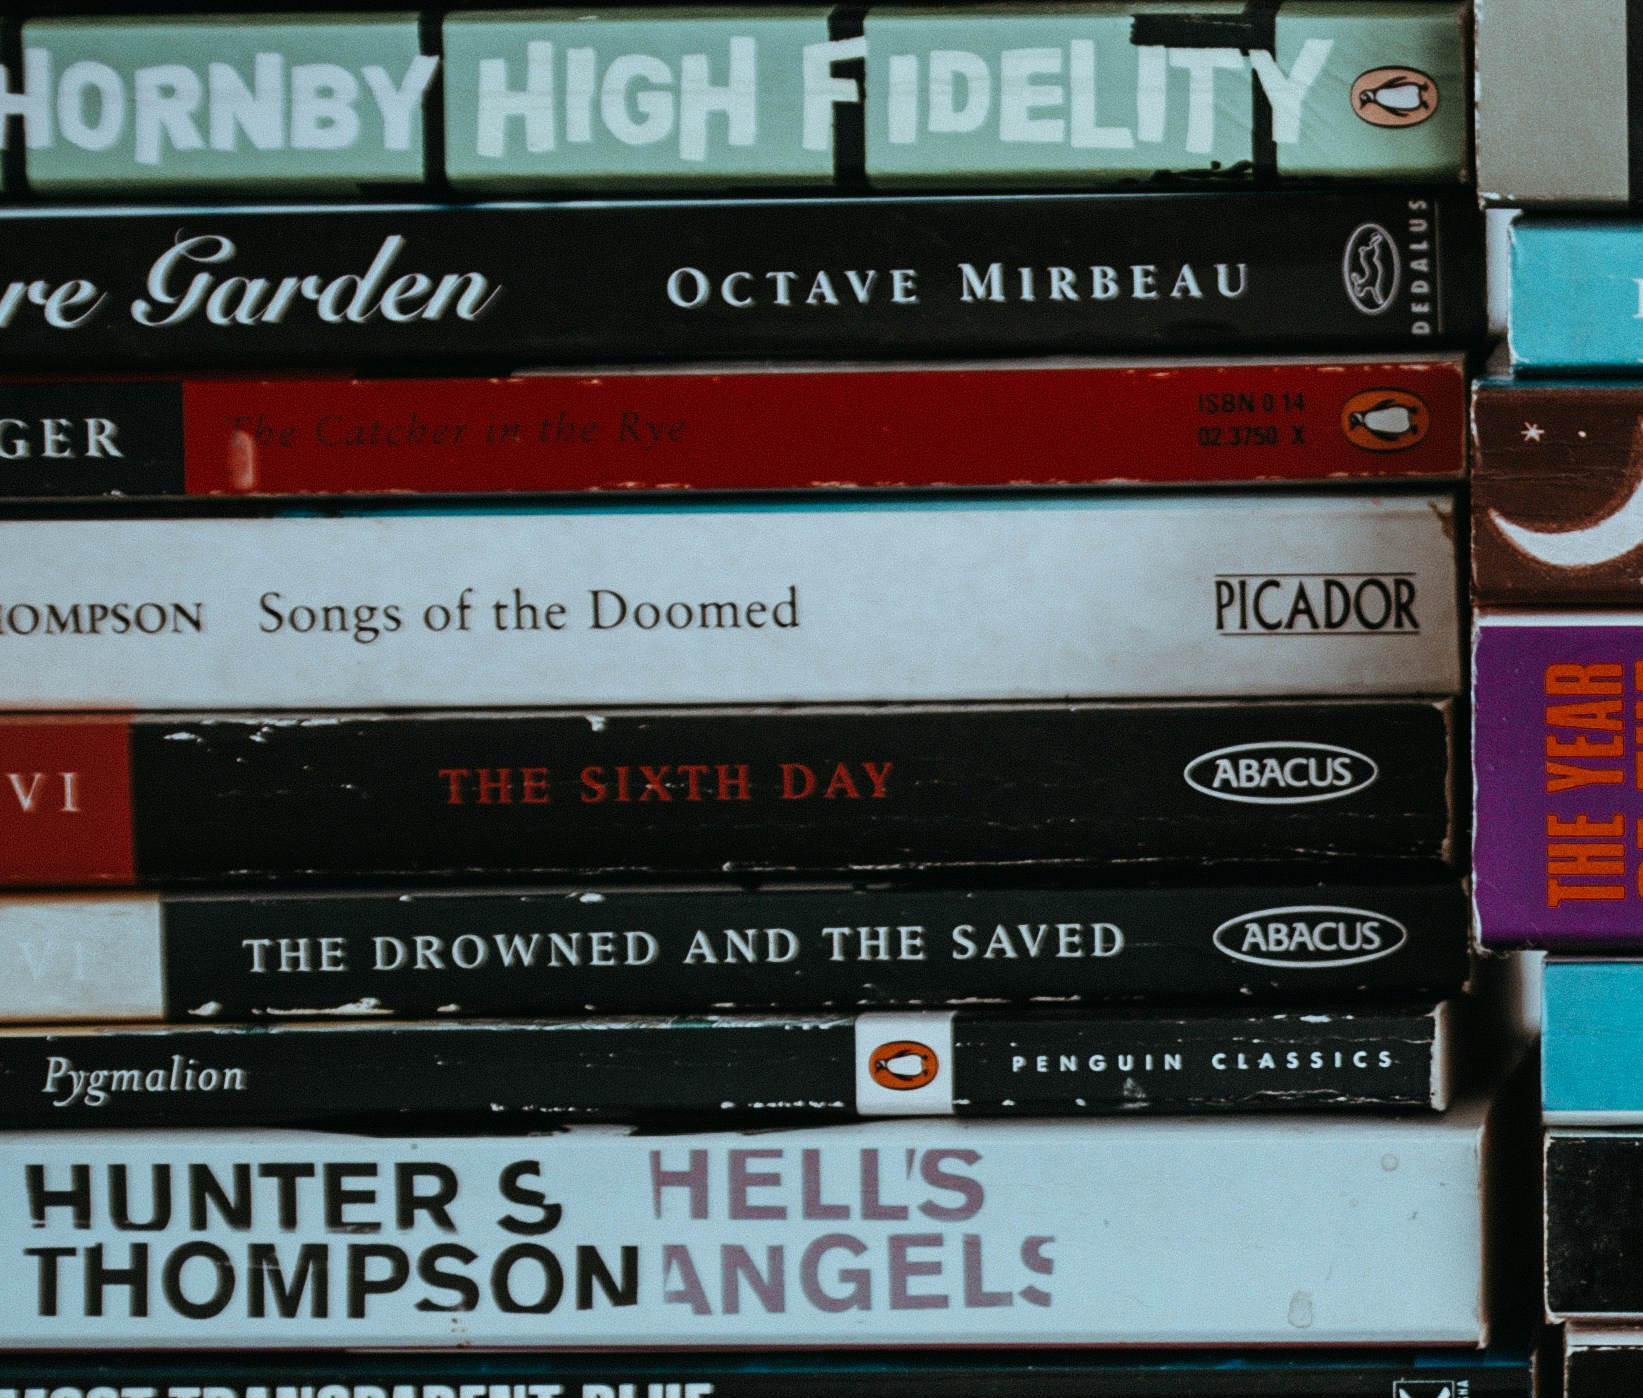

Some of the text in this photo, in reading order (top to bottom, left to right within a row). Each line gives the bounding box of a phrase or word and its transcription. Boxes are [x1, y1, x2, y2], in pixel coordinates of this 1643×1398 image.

[478, 37, 1334, 161] HIGH FIDELITY
[130, 228, 502, 328] Garden
[667, 263, 1246, 308] OCTAVE MIRBEAU
[1408, 200, 1431, 335] DEDALUS
[259, 585, 800, 645] Songs of the Doomed
[1214, 578, 1420, 630] PICADOR
[1210, 757, 1353, 789] ABACUS
[1545, 661, 1626, 908] THE YEAR
[242, 923, 1124, 973] THE DROWNED AND THE SAVED
[1241, 920, 1382, 953] ABACUS
[43, 1054, 246, 1107] Pygmalion
[1012, 1050, 1392, 1073] PENGUIN CLASSICS
